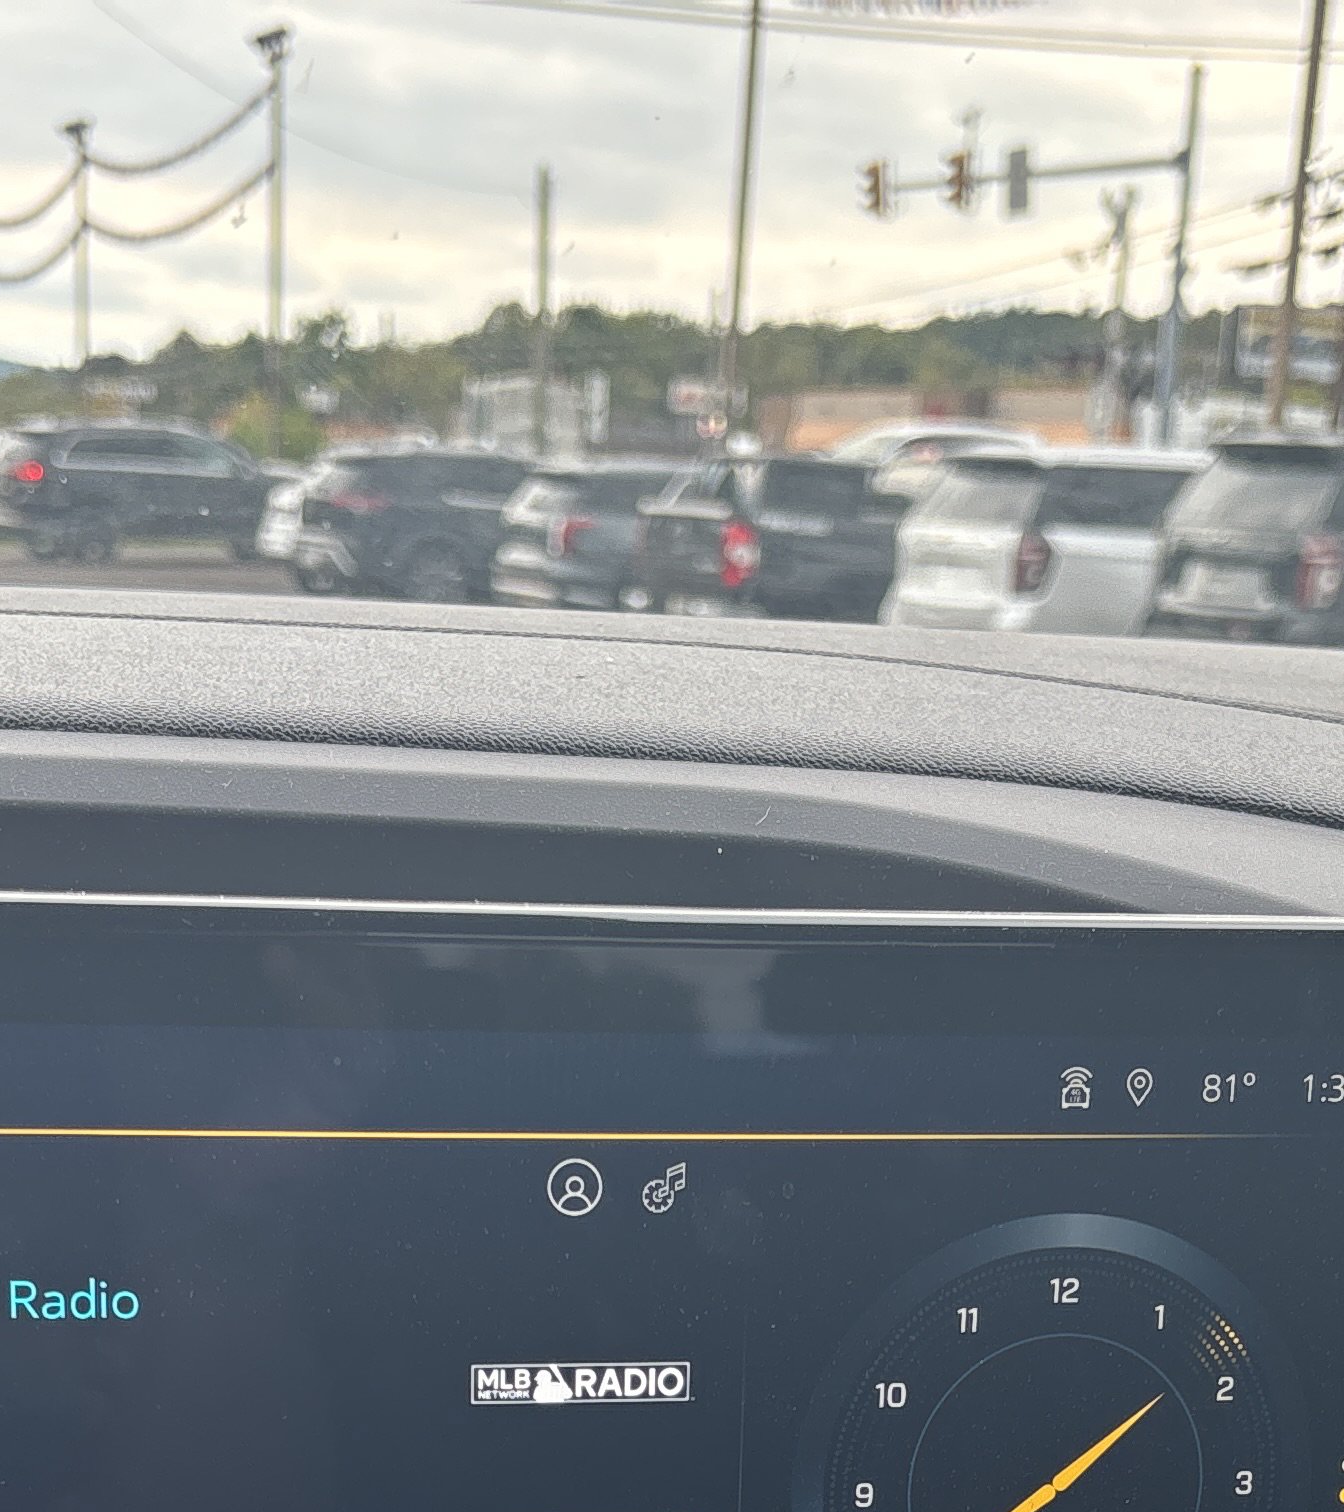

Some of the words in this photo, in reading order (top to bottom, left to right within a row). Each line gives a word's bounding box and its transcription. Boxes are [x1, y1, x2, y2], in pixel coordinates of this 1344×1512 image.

[1202, 1072, 1256, 1103] 81°
[9, 1277, 139, 1320] Radio
[1049, 1277, 1080, 1304] 12
[956, 1307, 978, 1334] 11
[1154, 1304, 1165, 1330] 1
[477, 1368, 531, 1390] MLB
[574, 1366, 685, 1398] RADIO
[477, 1389, 531, 1400] NETWORK
[875, 1382, 907, 1409] 10
[1216, 1376, 1234, 1402] 2
[855, 1482, 874, 1508] 9
[1234, 1470, 1253, 1495] 3
